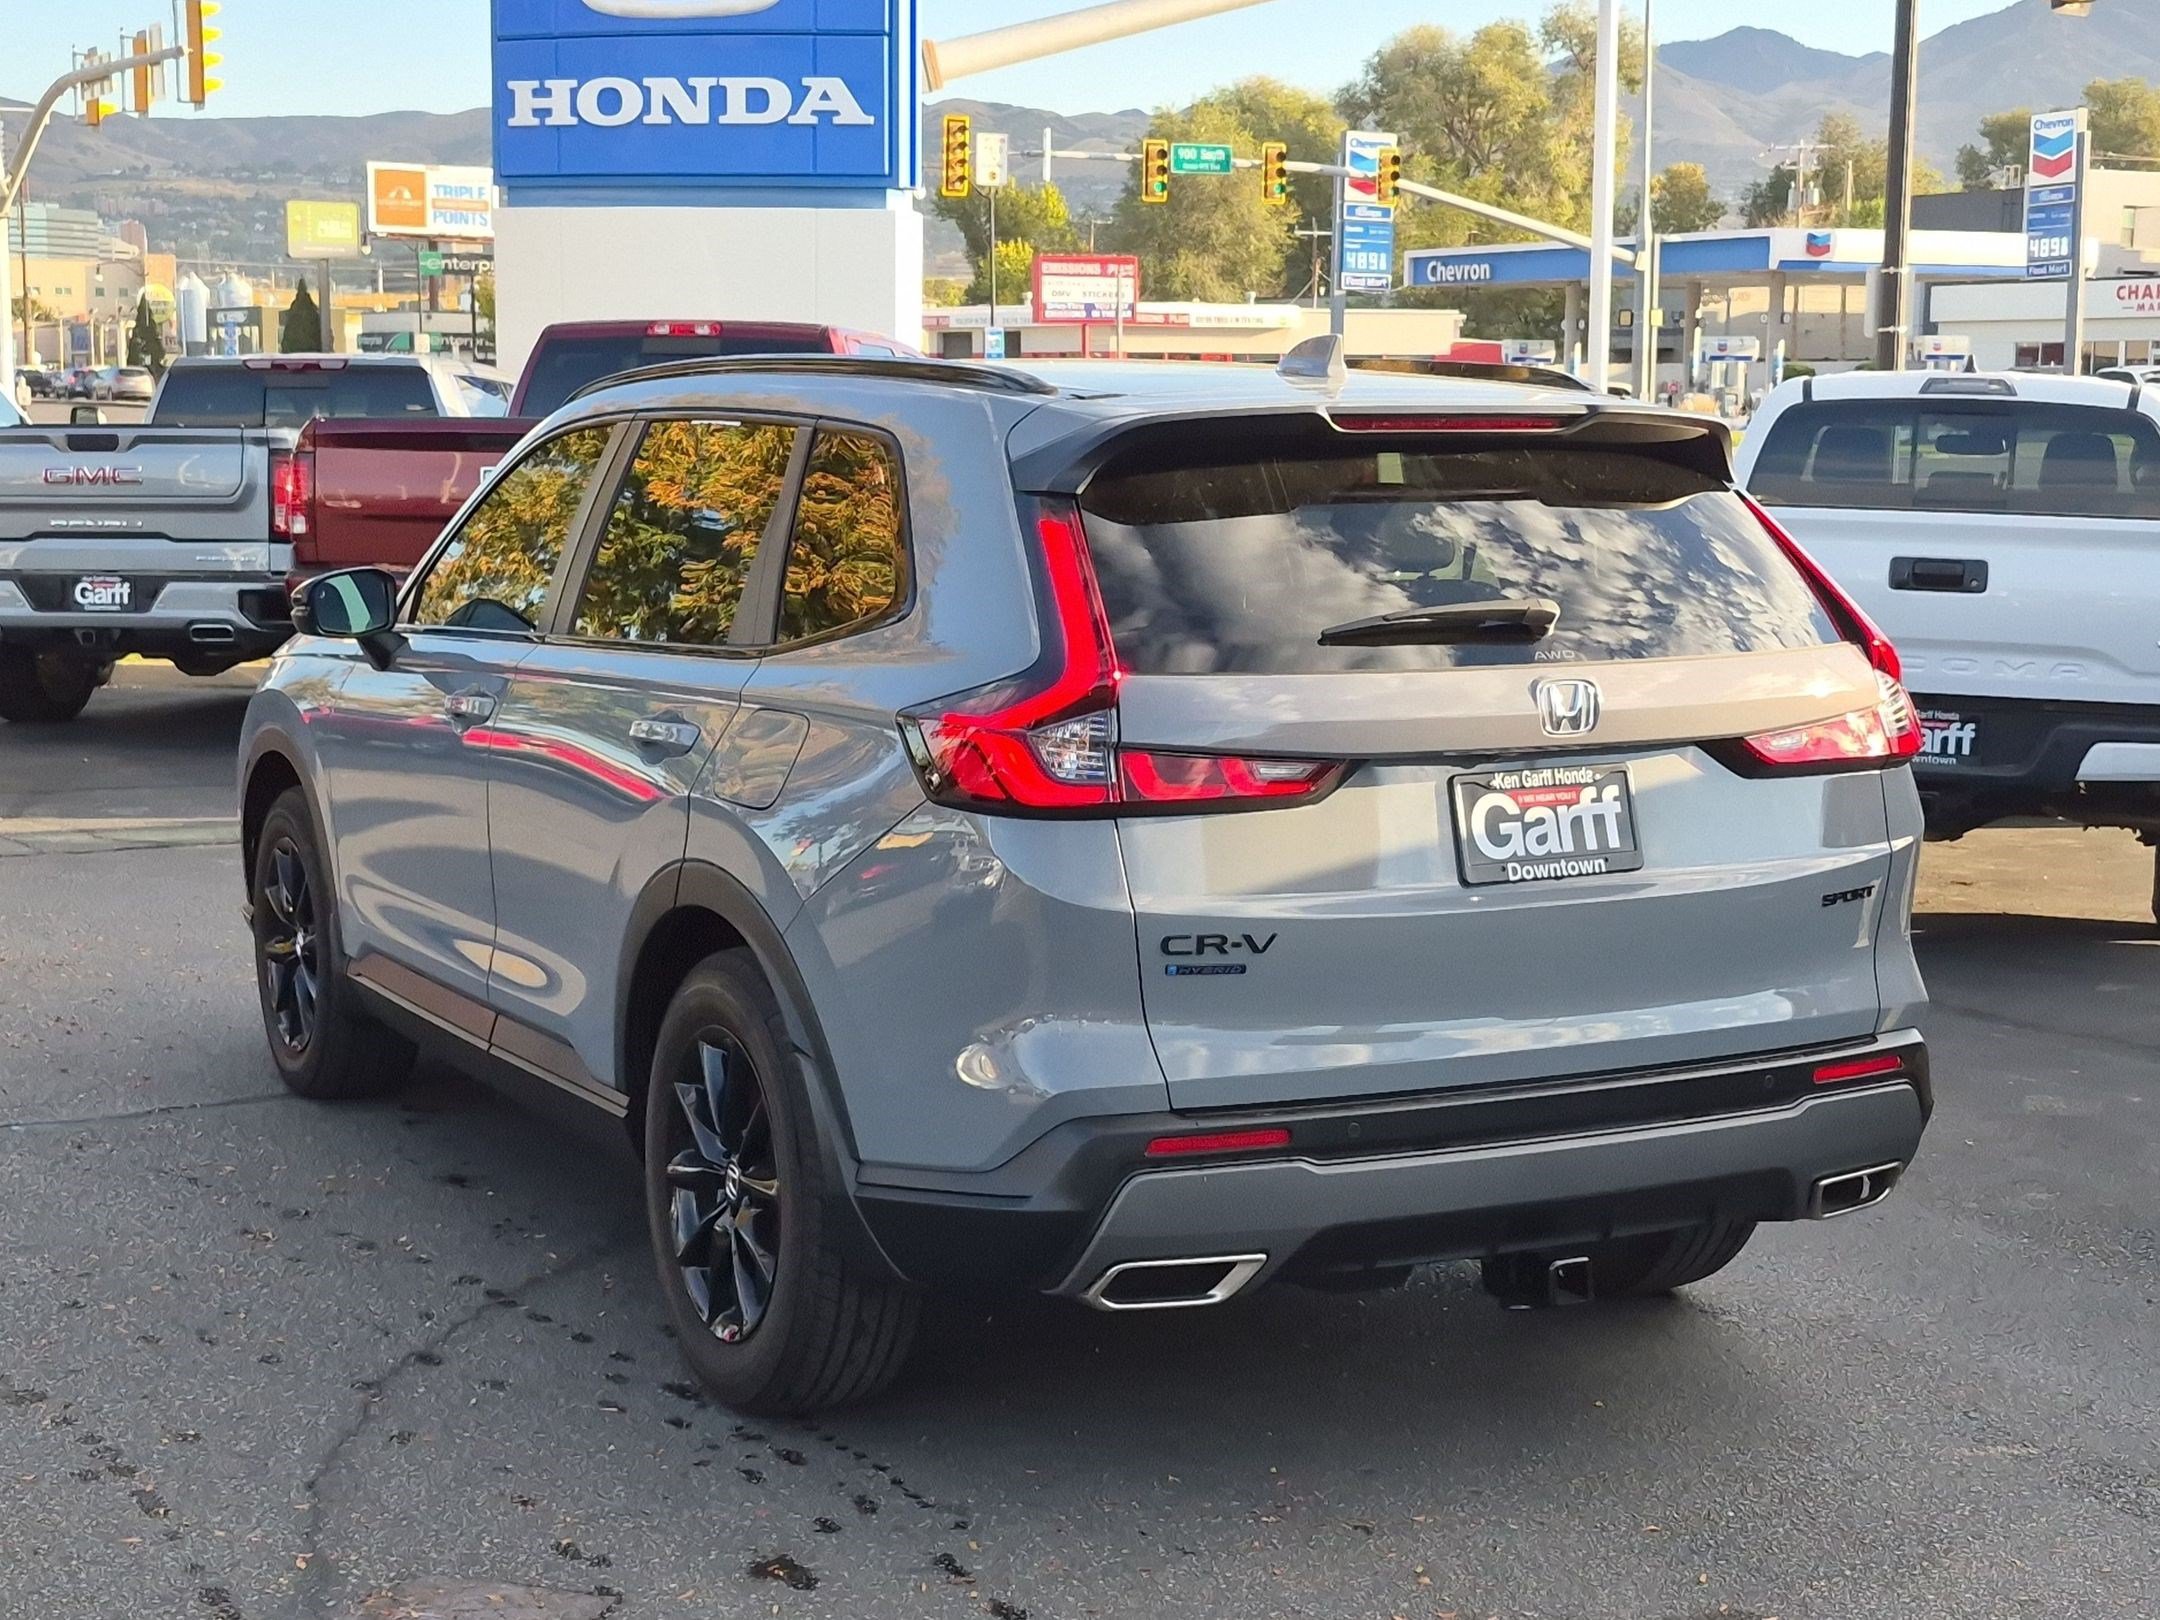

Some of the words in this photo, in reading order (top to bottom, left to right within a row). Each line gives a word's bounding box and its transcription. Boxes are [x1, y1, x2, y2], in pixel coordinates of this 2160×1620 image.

[507, 77, 875, 127] HONDA
[2033, 117, 2074, 131] Chevron
[433, 184, 486, 200] TRIPLE
[433, 210, 489, 226] POINTS
[427, 257, 494, 273] enterp
[1426, 260, 1491, 283] Chevron
[43, 466, 143, 485] GMC
[75, 581, 131, 605] Garff
[1534, 649, 1575, 661] AWD
[1493, 771, 1520, 790] Ken
[1521, 769, 1554, 788] Garff
[1554, 767, 1594, 785] Honda
[1471, 784, 1622, 860] Garff
[1507, 858, 1607, 881] Downtown
[1822, 885, 1875, 907] SPORT
[1160, 932, 1278, 955] CR-V
